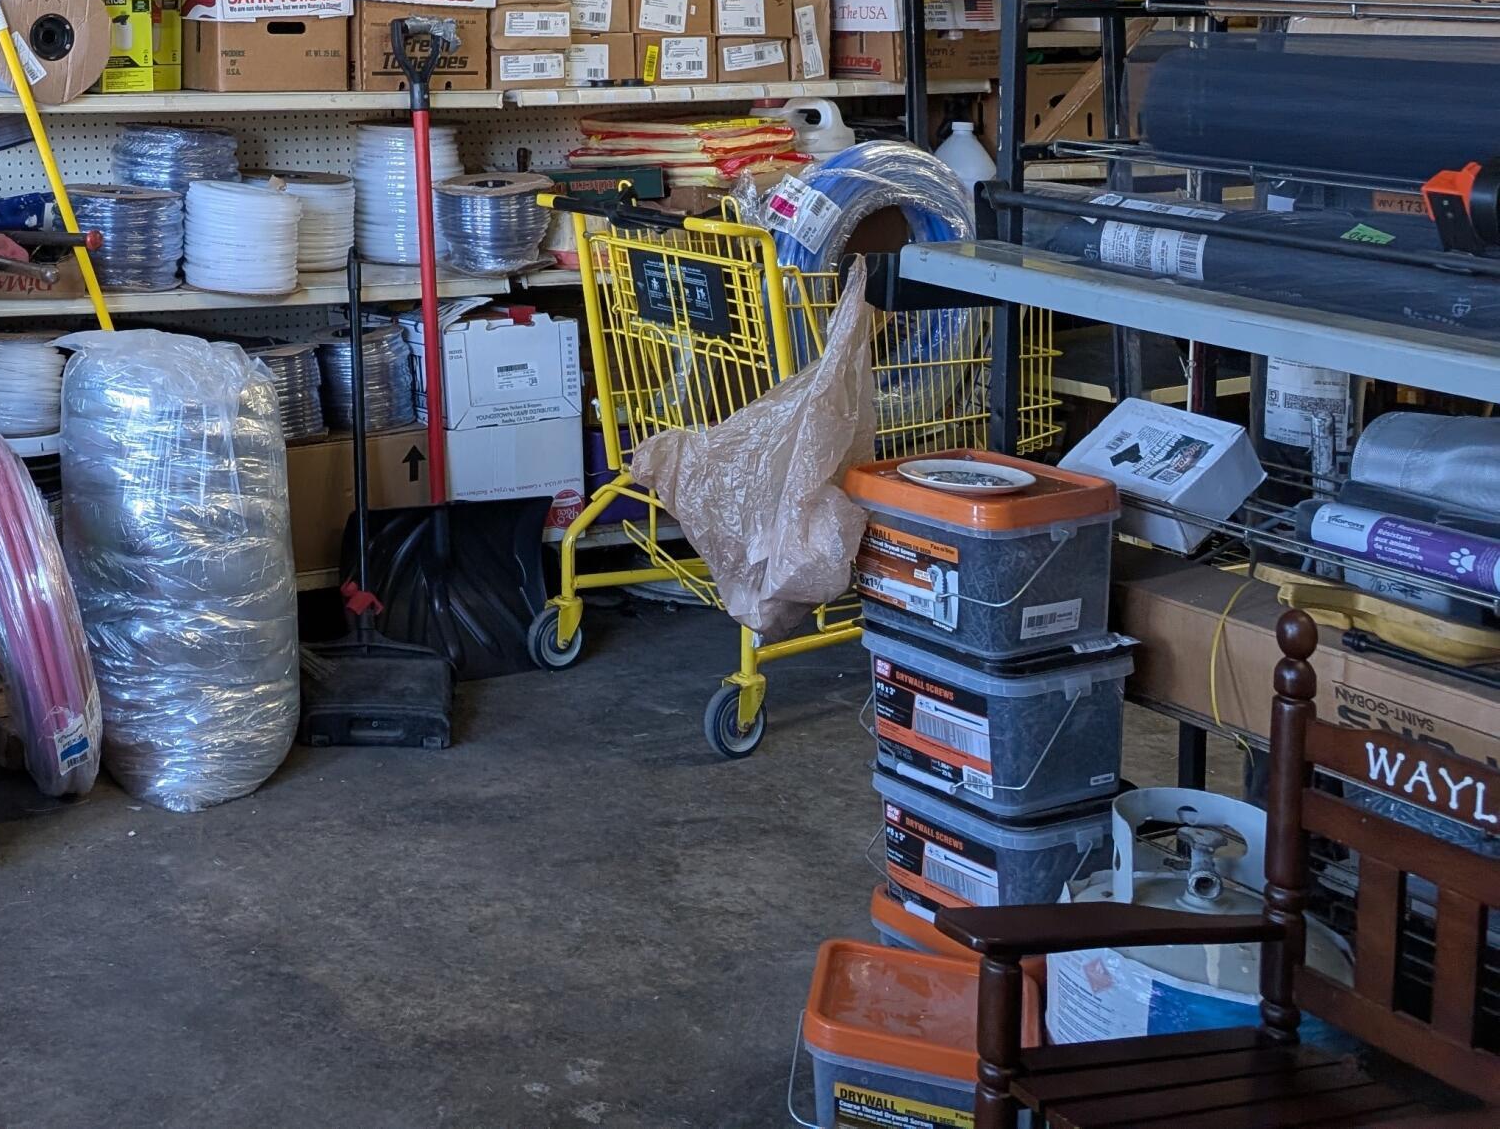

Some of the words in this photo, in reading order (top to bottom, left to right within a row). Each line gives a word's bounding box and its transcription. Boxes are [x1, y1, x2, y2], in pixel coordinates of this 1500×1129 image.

[229, 5, 237, 13] We
[255, 4, 263, 12] the
[282, 3, 291, 11] but
[291, 3, 299, 11] we
[299, 3, 307, 11] are
[839, 6, 858, 20] The
[858, 6, 888, 20] USA
[221, 50, 245, 58] PRODUCE
[230, 59, 237, 67] OF
[1373, 535, 1388, 545] aux
[1388, 537, 1421, 553] animaux
[1377, 527, 1413, 543] Résistant
[1373, 542, 1383, 552] de
[1384, 545, 1424, 562] compagnie
[896, 670, 925, 691] DRYWALL
[925, 682, 954, 702] SCREWS
[1334, 686, 1435, 733] SAINT-GOBAIN
[1365, 741, 1498, 825] WAYL
[935, 831, 964, 851] SCREWS
[839, 1087, 898, 1113] DRYWALL
[861, 1105, 884, 1118] Thread
[884, 1111, 909, 1123] Drywall
